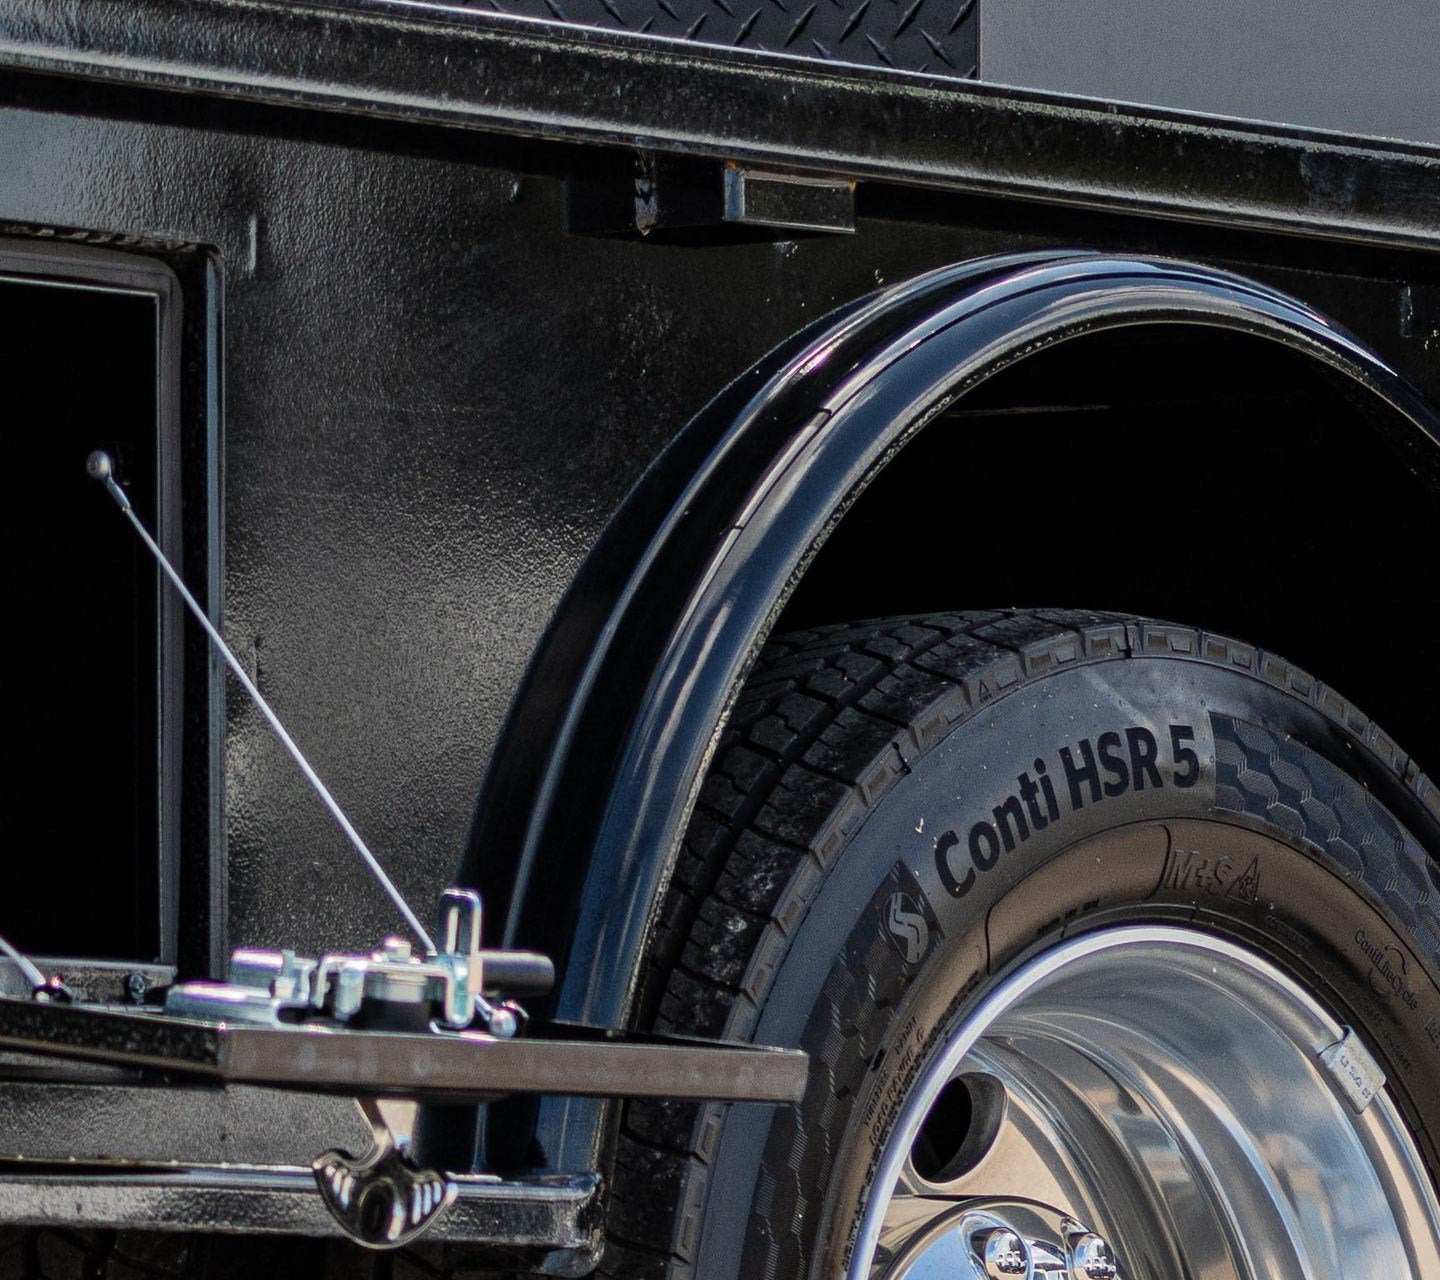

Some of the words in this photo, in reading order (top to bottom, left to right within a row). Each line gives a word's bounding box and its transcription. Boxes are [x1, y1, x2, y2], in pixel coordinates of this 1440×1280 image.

[933, 758, 1059, 899] Conti
[1059, 724, 1161, 812] HSR
[1166, 724, 1200, 788] 5
